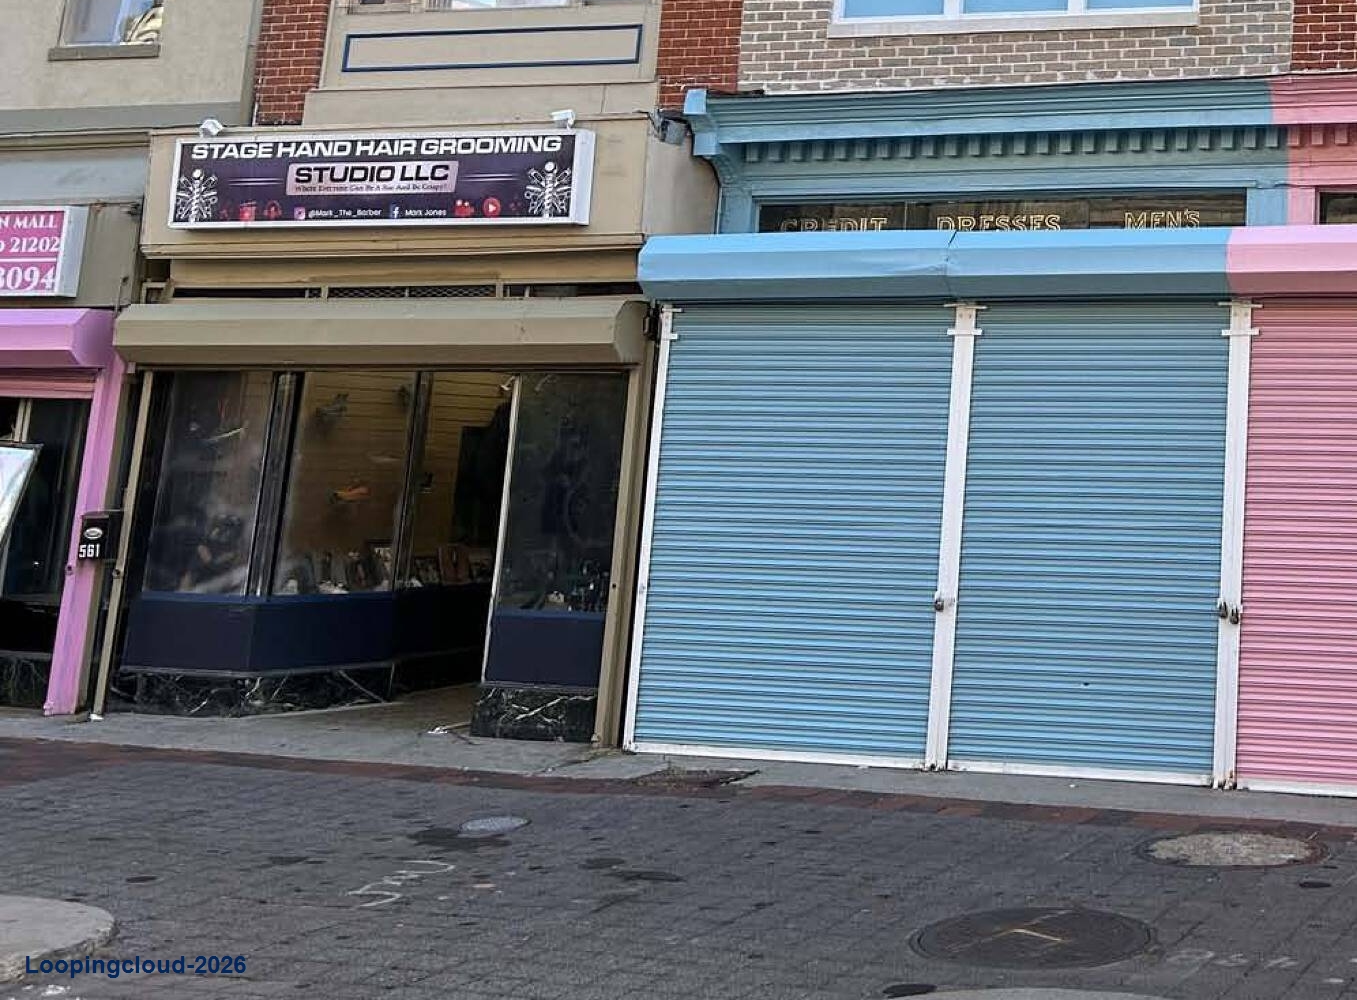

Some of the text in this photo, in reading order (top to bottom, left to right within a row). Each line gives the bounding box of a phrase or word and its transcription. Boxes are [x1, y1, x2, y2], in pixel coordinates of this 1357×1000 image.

[192, 135, 562, 159] STAGE HAND HAIR GROOMING
[295, 164, 449, 184] STUDIO LLC
[13, 215, 57, 229] MALL
[9, 236, 61, 253] 21202
[79, 544, 100, 557] 561
